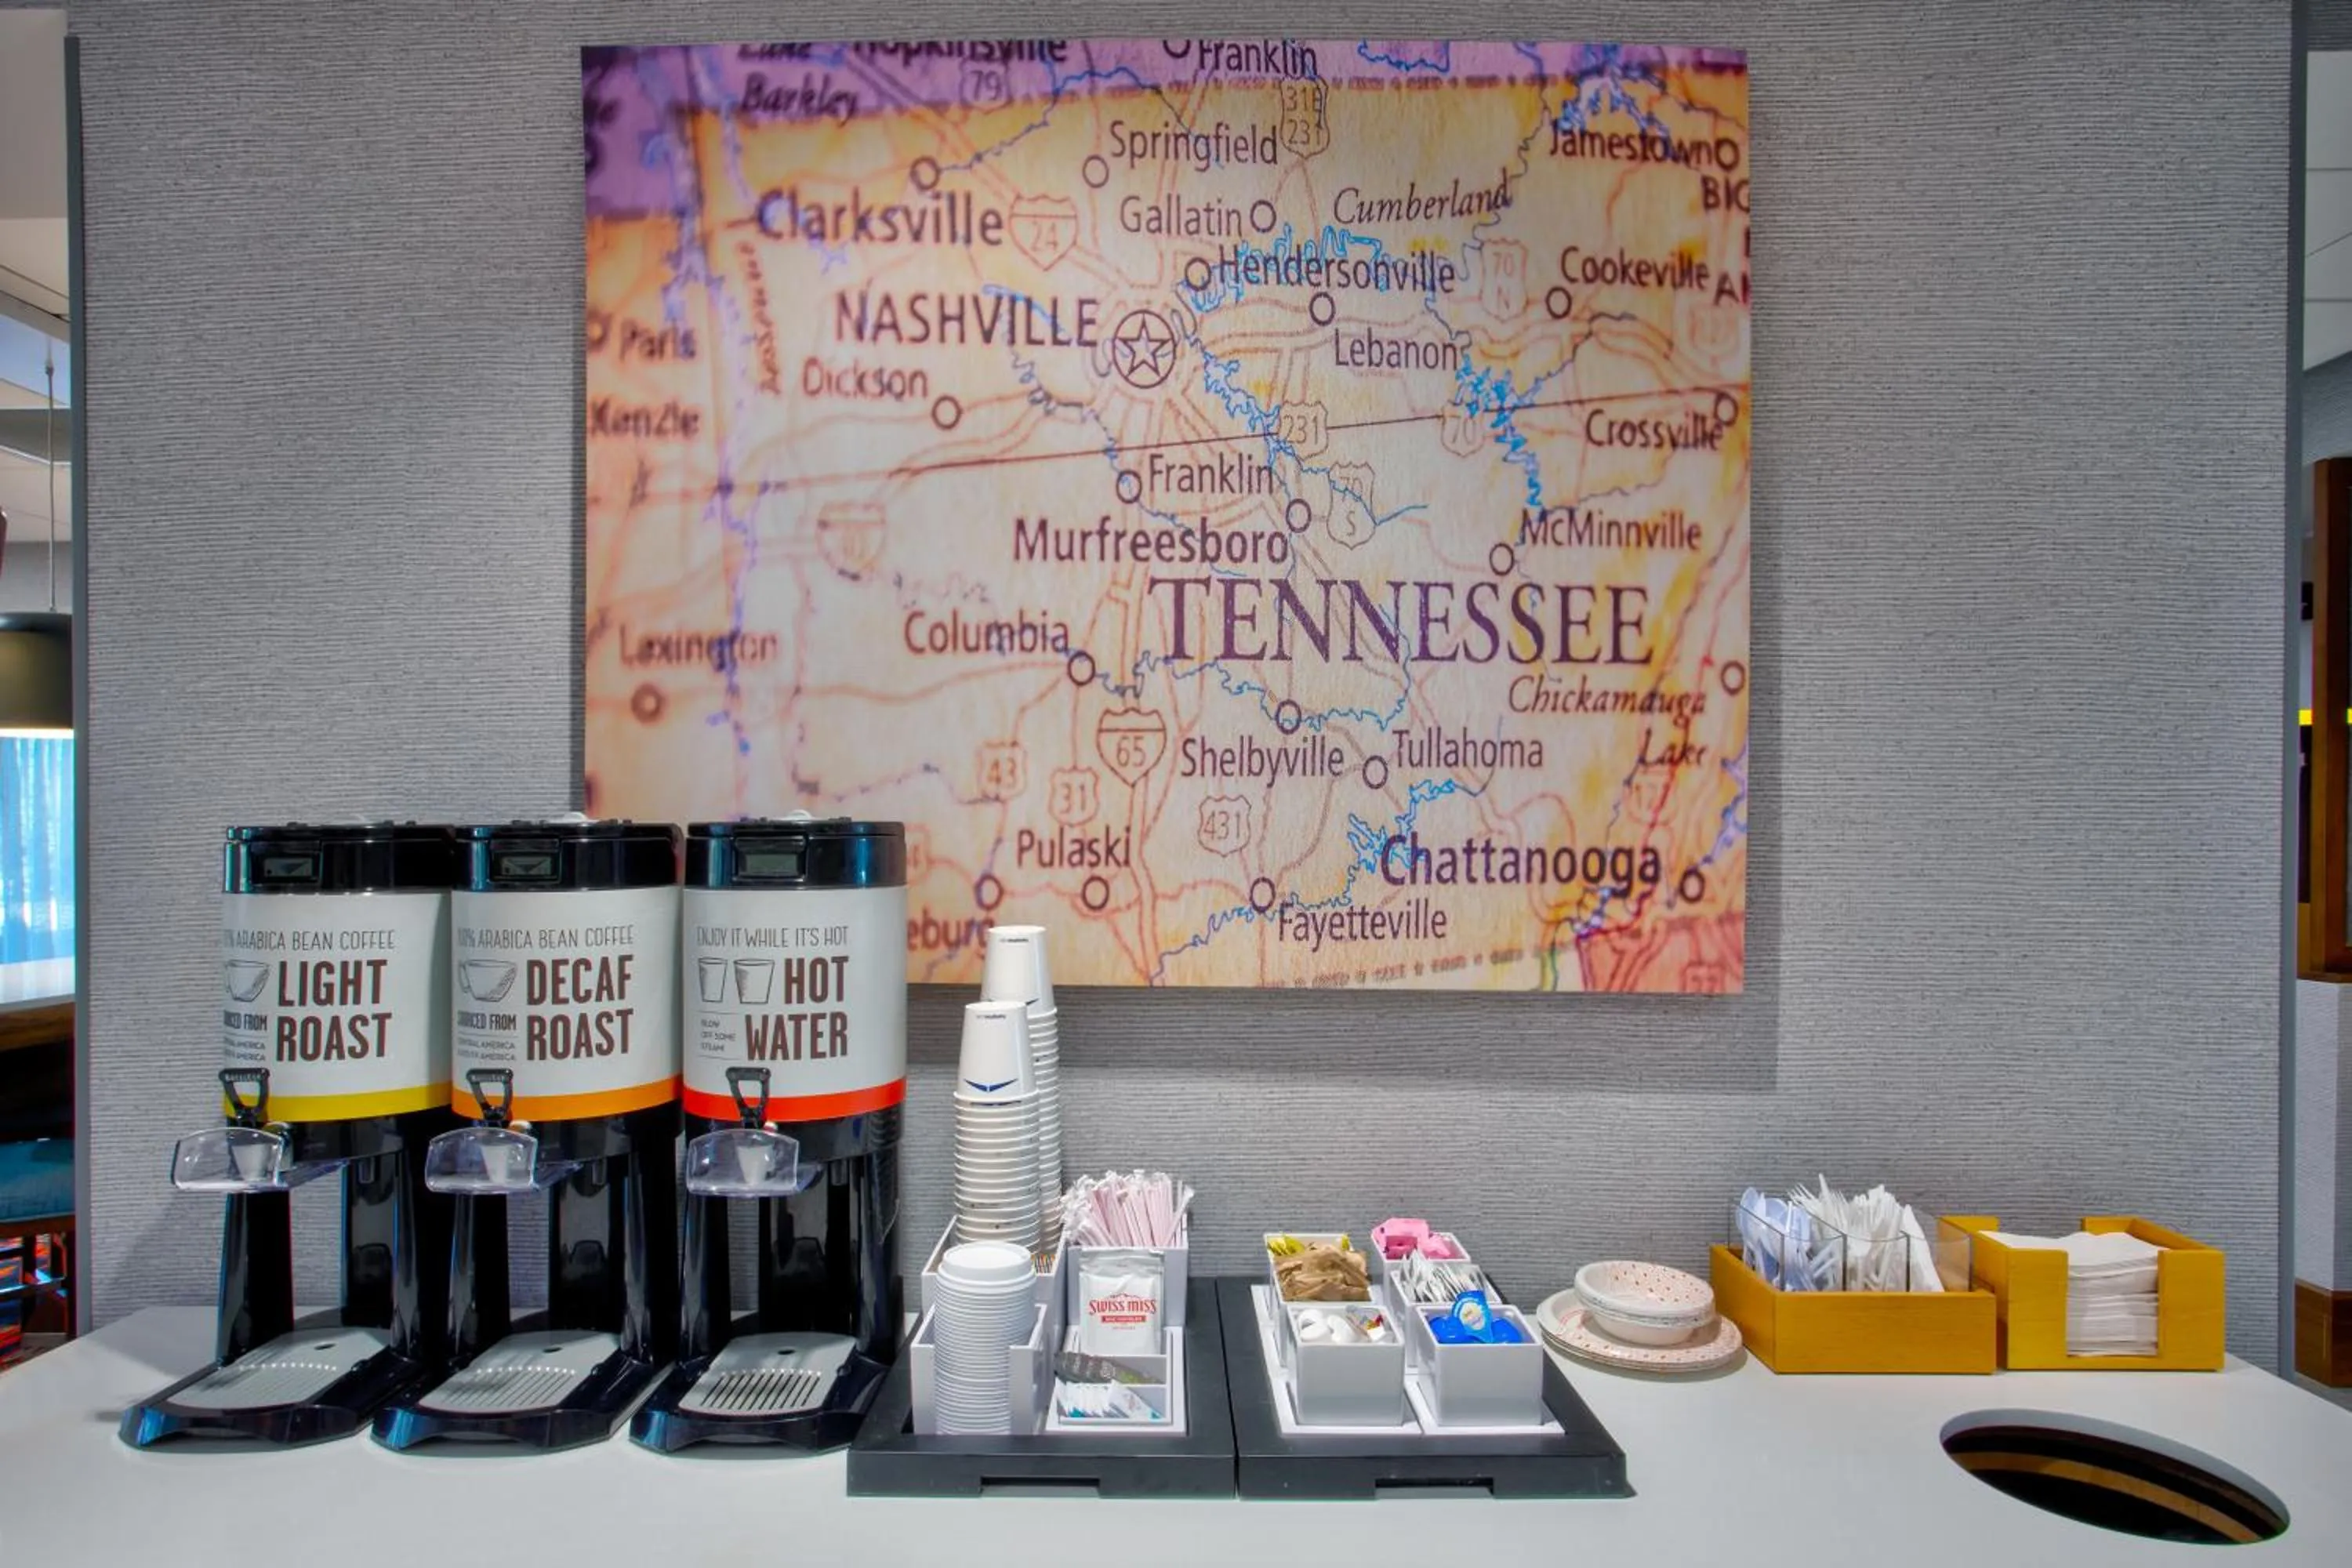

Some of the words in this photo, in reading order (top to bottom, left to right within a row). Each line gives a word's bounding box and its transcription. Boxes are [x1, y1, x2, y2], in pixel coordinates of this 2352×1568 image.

[1198, 39, 1318, 78] Franklin
[739, 72, 860, 126] Barkley
[971, 70, 1003, 101] 79
[1110, 120, 1279, 172] Springfield
[1287, 118, 1321, 146] 231
[1550, 122, 1712, 163] Jamestown
[758, 186, 1003, 246] Clarksville
[1120, 194, 1242, 237] Gallatin
[1334, 166, 1511, 227] Cumberland
[1219, 244, 1455, 293] Hendersonville
[1561, 245, 1710, 290] Cookeville
[834, 290, 1098, 347] NASHVILLE
[1334, 328, 1457, 371] Lebanon
[802, 357, 928, 399] Dickson
[1283, 414, 1319, 445] 231
[1587, 409, 1722, 451] Crossville
[1149, 452, 1273, 494] Franklin
[1014, 515, 1289, 564] Murfreesboro
[1523, 510, 1702, 550] McMinnville
[904, 608, 1069, 655] Columbia
[1147, 575, 1653, 665] TENNESSEE
[619, 624, 778, 673] Lexington
[1508, 674, 1706, 728] Chickamauga
[1116, 737, 1146, 768] 65
[1181, 735, 1345, 788] Shelbyville
[1392, 728, 1543, 768] Tullahoma
[986, 759, 1017, 785] 43
[1062, 786, 1087, 814] 31
[1018, 825, 1131, 868] Pulaski
[1203, 811, 1243, 840] 431
[1381, 831, 1661, 899] Chattanooga
[237, 930, 286, 951] ARABICA
[292, 931, 333, 951] BEAN
[339, 929, 396, 950] COFFEE
[477, 928, 533, 949] ARABICA
[539, 929, 579, 949] BEAN
[585, 925, 634, 946] COFFEE
[731, 927, 742, 948] IT
[744, 927, 789, 949] WHILE
[796, 927, 819, 947] IT'S
[824, 926, 849, 946] HOT
[1279, 898, 1447, 953] Fayetteville
[278, 959, 388, 1007] LIGHT
[526, 954, 634, 1006] DECAF
[785, 956, 850, 1005] HOT
[244, 1014, 267, 1031] FROM
[276, 1012, 393, 1062] ROAST
[489, 1013, 517, 1031] FROM
[526, 1008, 634, 1061] ROAST
[745, 1011, 848, 1061] WATER
[1088, 1300, 1125, 1316] SWISS
[1127, 1299, 1157, 1315] MISS
